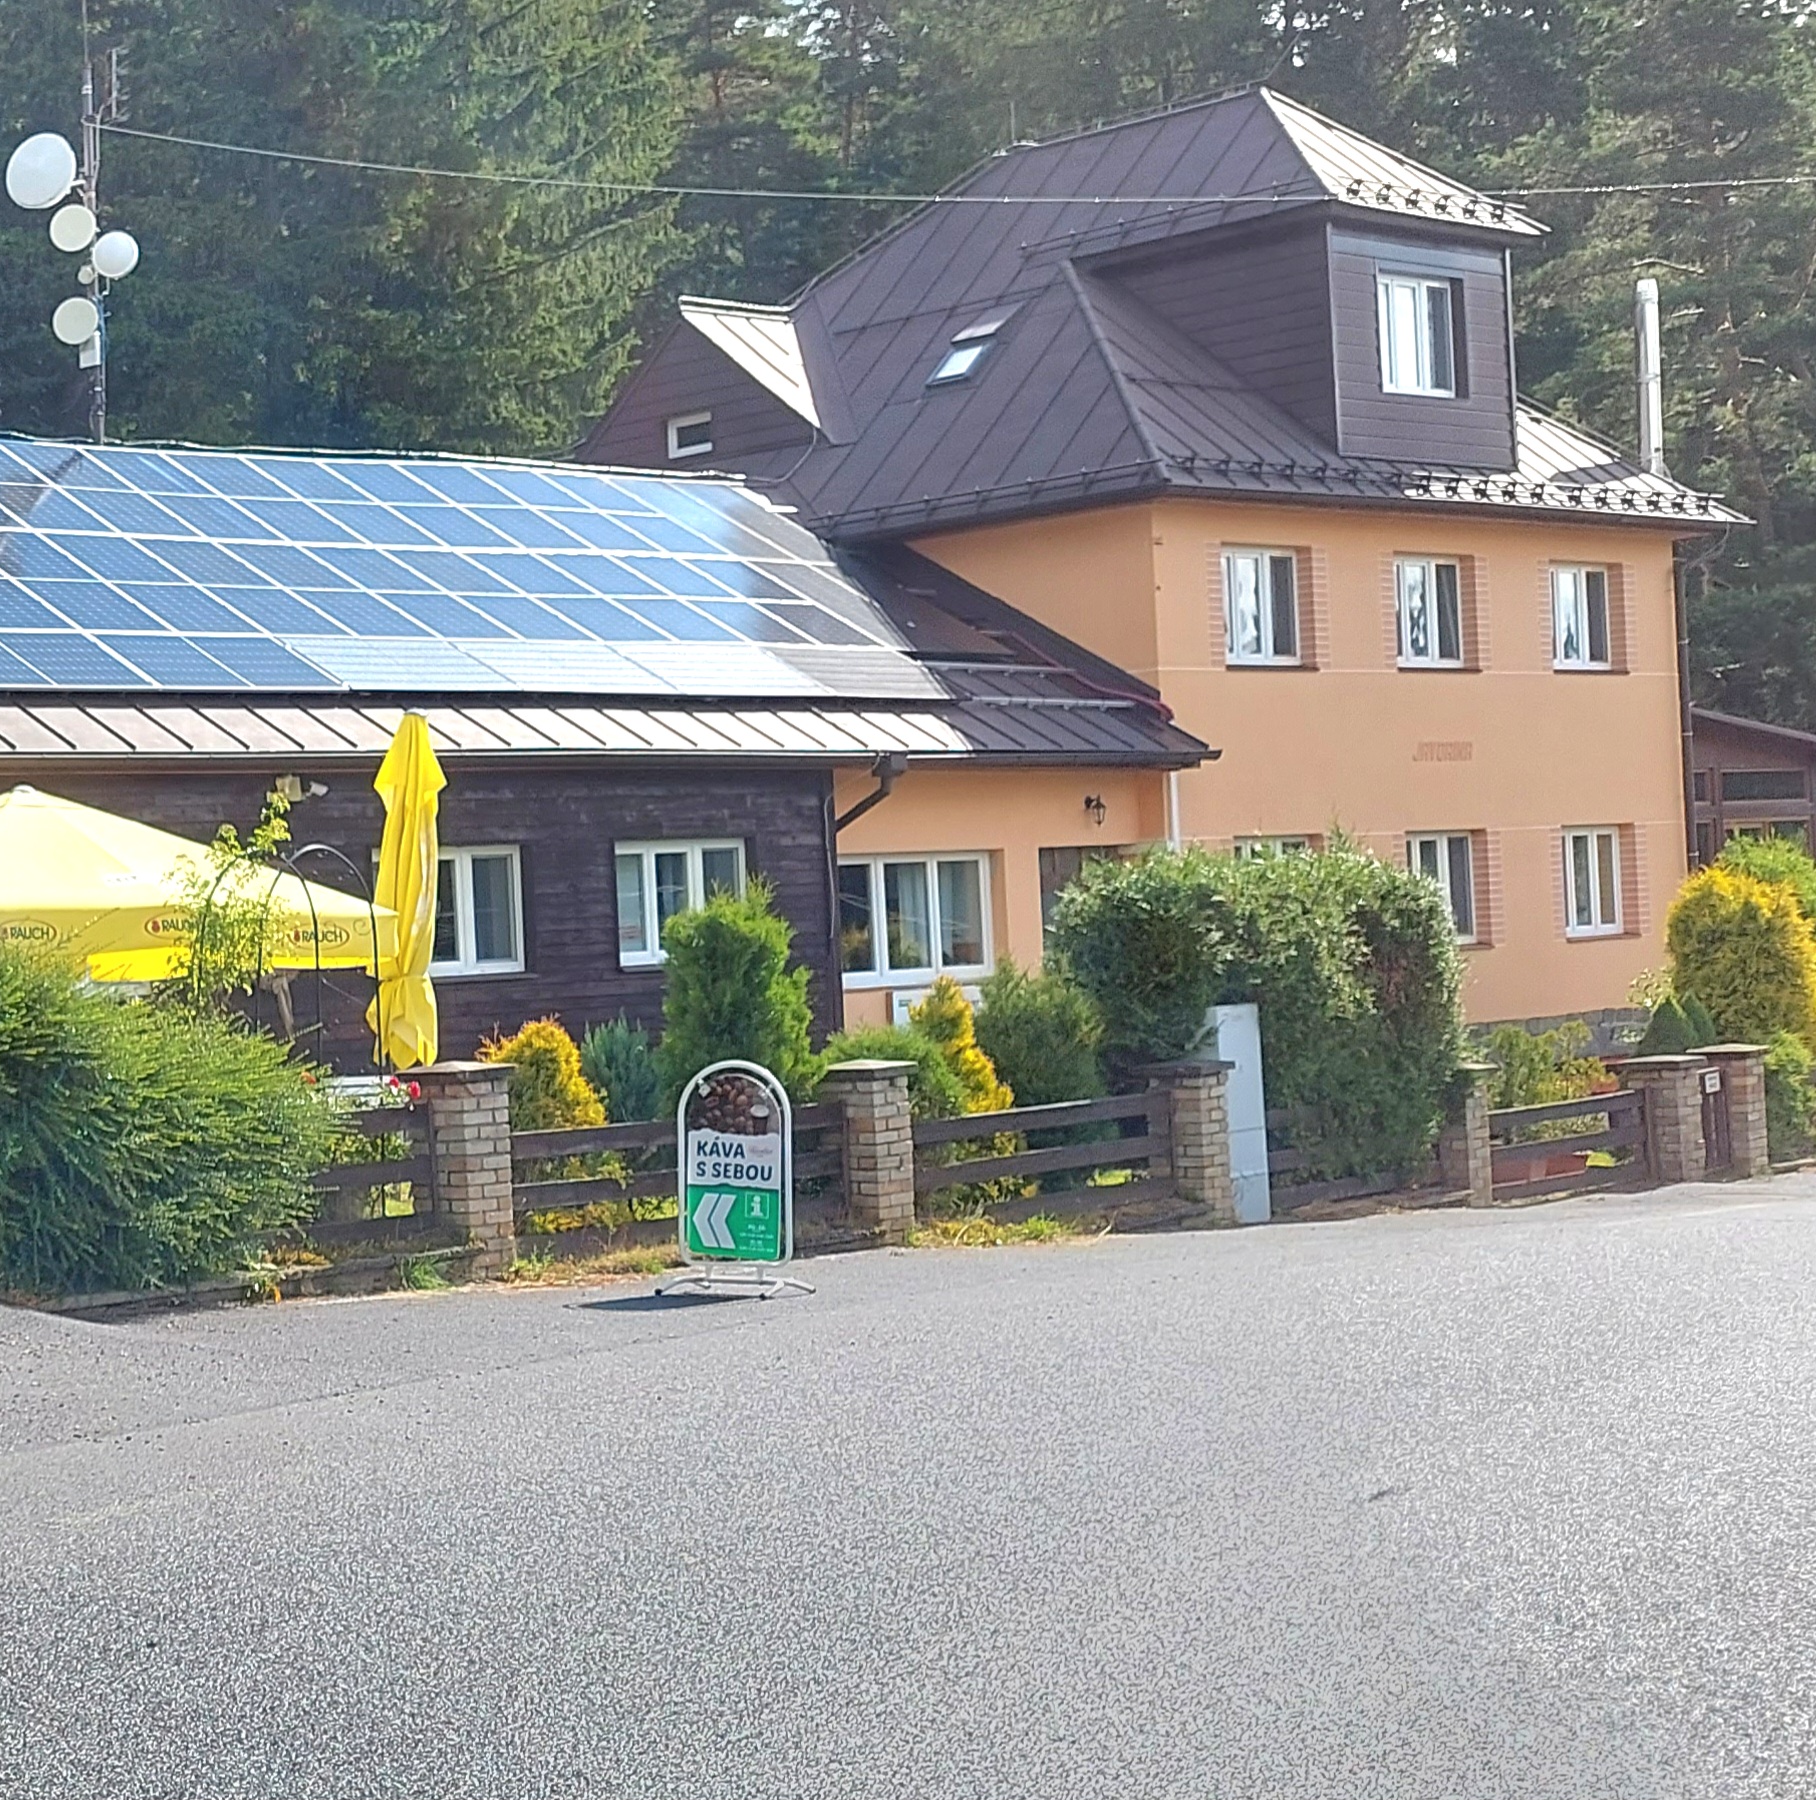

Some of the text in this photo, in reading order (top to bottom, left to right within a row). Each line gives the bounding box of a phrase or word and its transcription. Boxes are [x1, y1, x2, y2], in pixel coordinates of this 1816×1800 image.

[10, 928, 50, 940] RAUCH
[696, 1136, 746, 1159] KÁVA
[696, 1161, 773, 1182] S SEBOU
